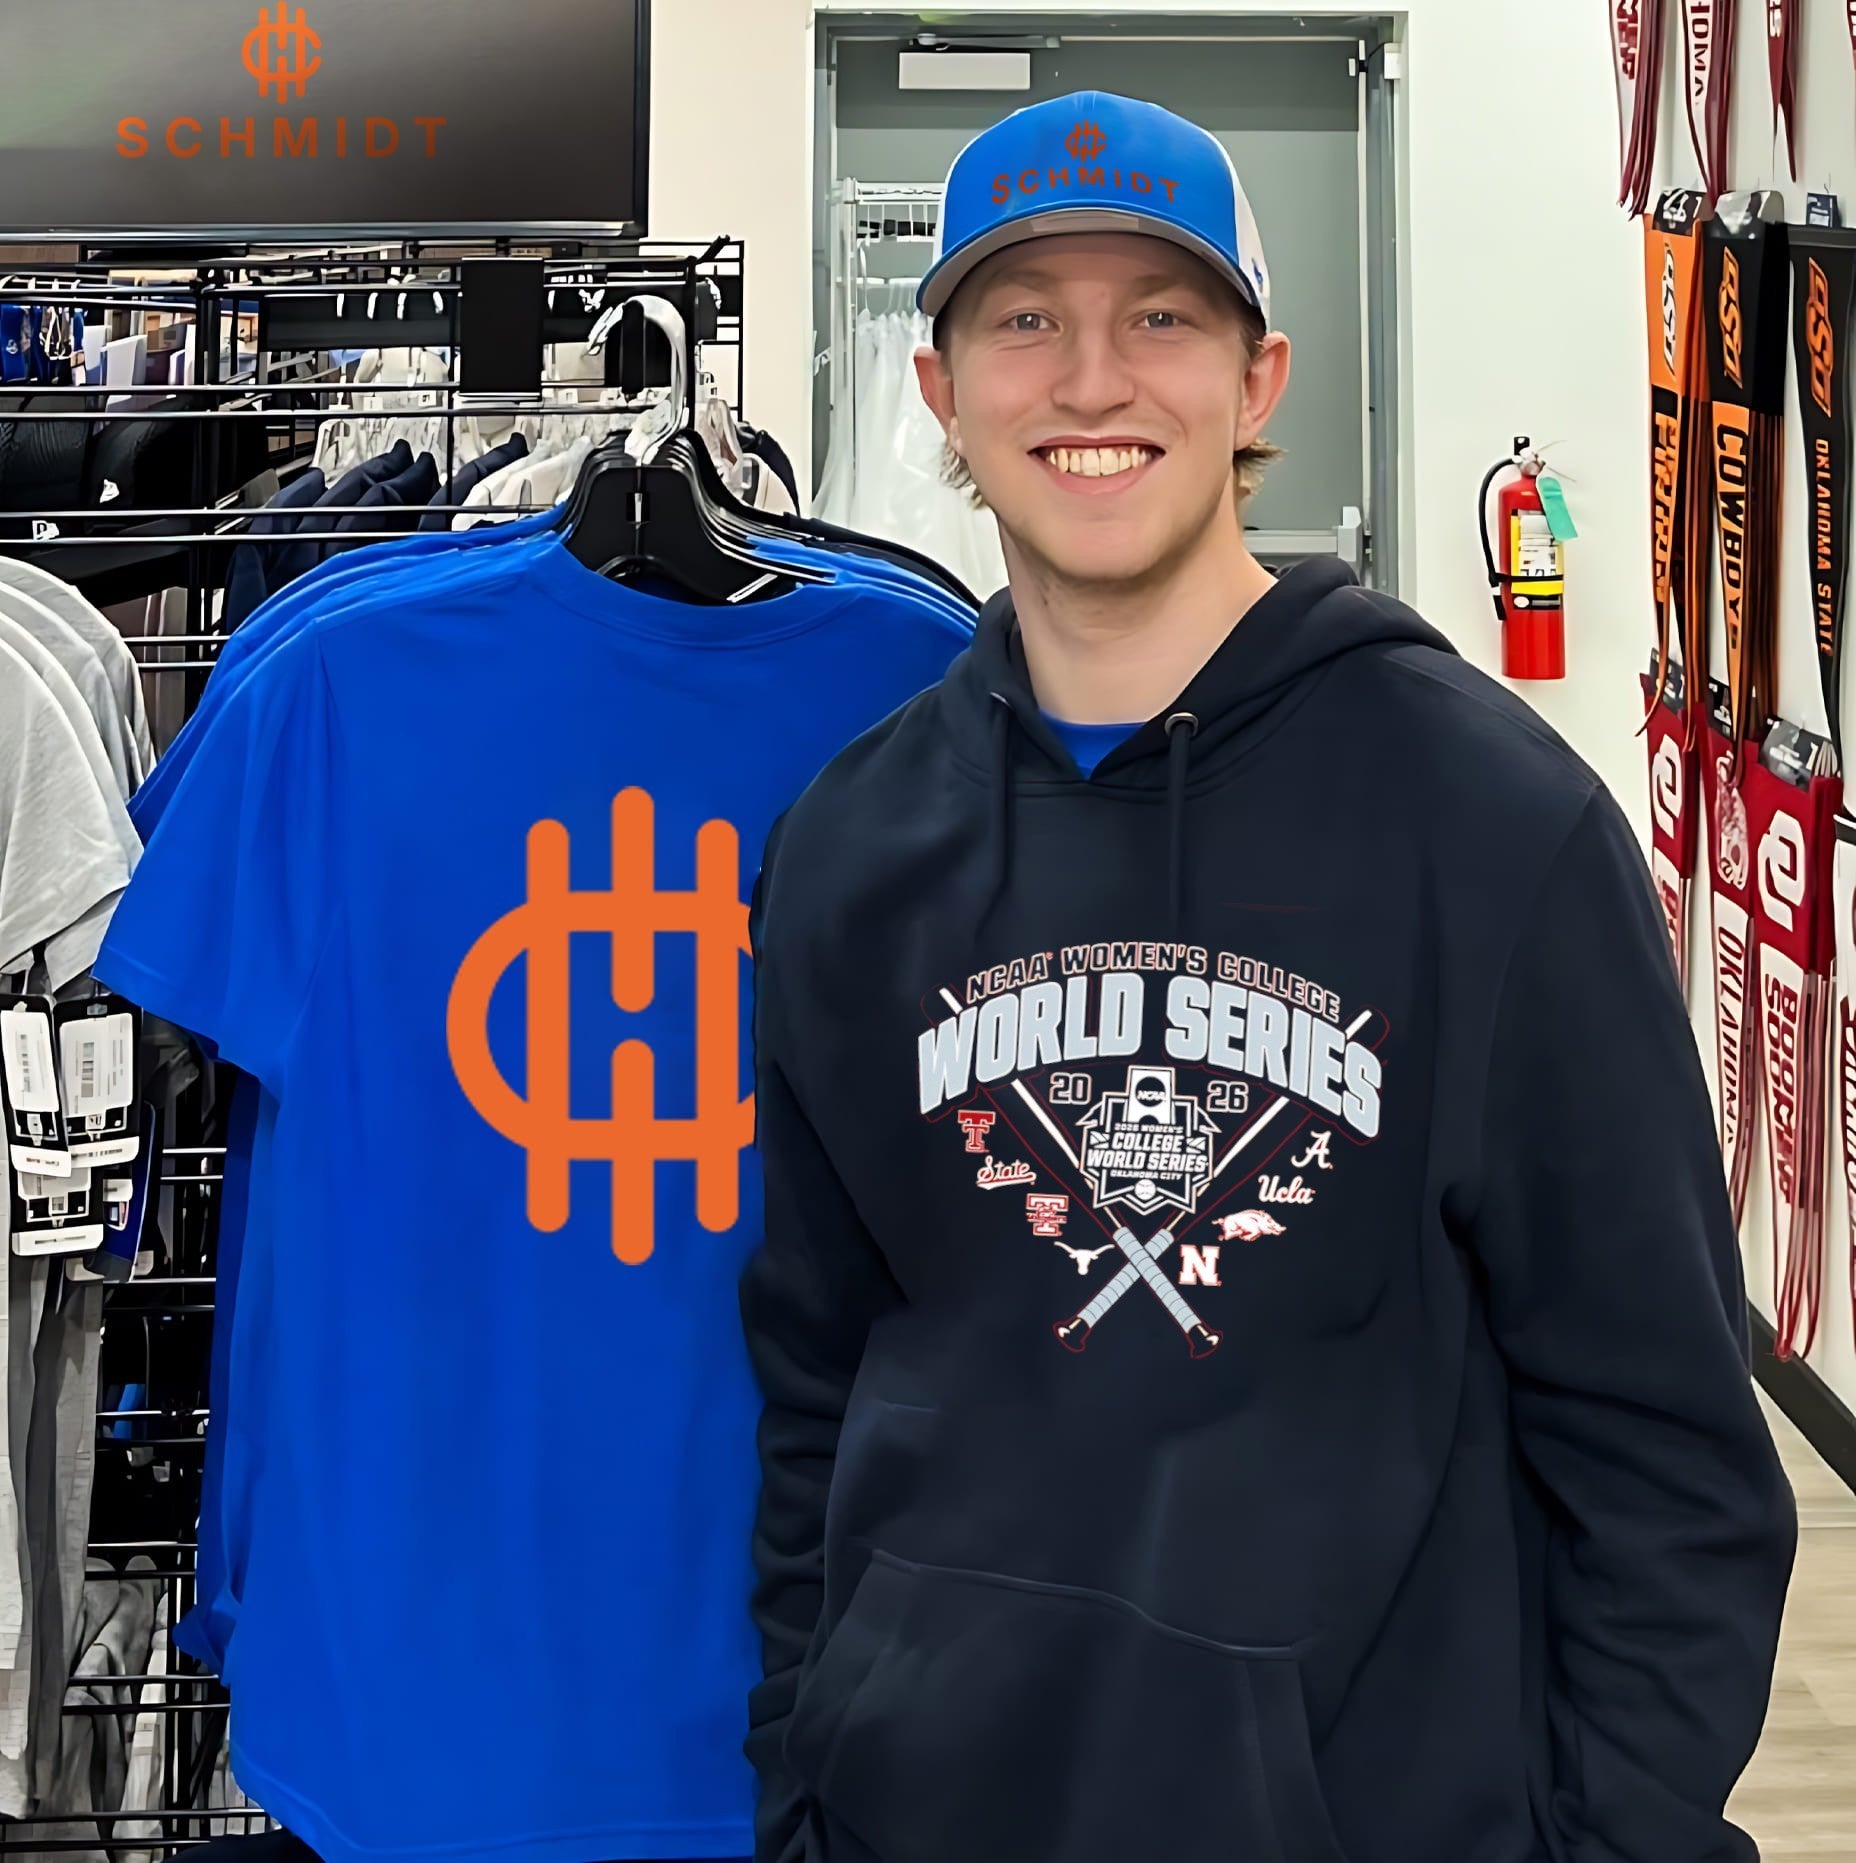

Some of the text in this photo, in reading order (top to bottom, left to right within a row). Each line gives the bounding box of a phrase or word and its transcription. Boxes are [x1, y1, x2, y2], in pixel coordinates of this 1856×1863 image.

[115, 116, 447, 159] SCHMIDT
[991, 166, 1179, 204] SCHMIDT
[1815, 438, 1832, 570] OKLAHOMA
[1060, 942, 1208, 975] WOMEN'S
[1217, 951, 1341, 1023] COLLEGE
[1717, 924, 1746, 1144] OKLAHOMA
[918, 972, 1382, 1138] WORLD SERIES
[1049, 1072, 1249, 1113] 20 26
[1136, 1089, 1167, 1102] NCAA
[1111, 1131, 1184, 1153] COLLEGE
[1140, 1124, 1184, 1134] WOMEN'S
[976, 1155, 1037, 1190] State
[1086, 1149, 1208, 1173] WORLD SERIES
[1110, 1169, 1183, 1181] OKLAHOMA CITY
[1258, 1174, 1314, 1204] Ucla
[1179, 1244, 1221, 1286] N
